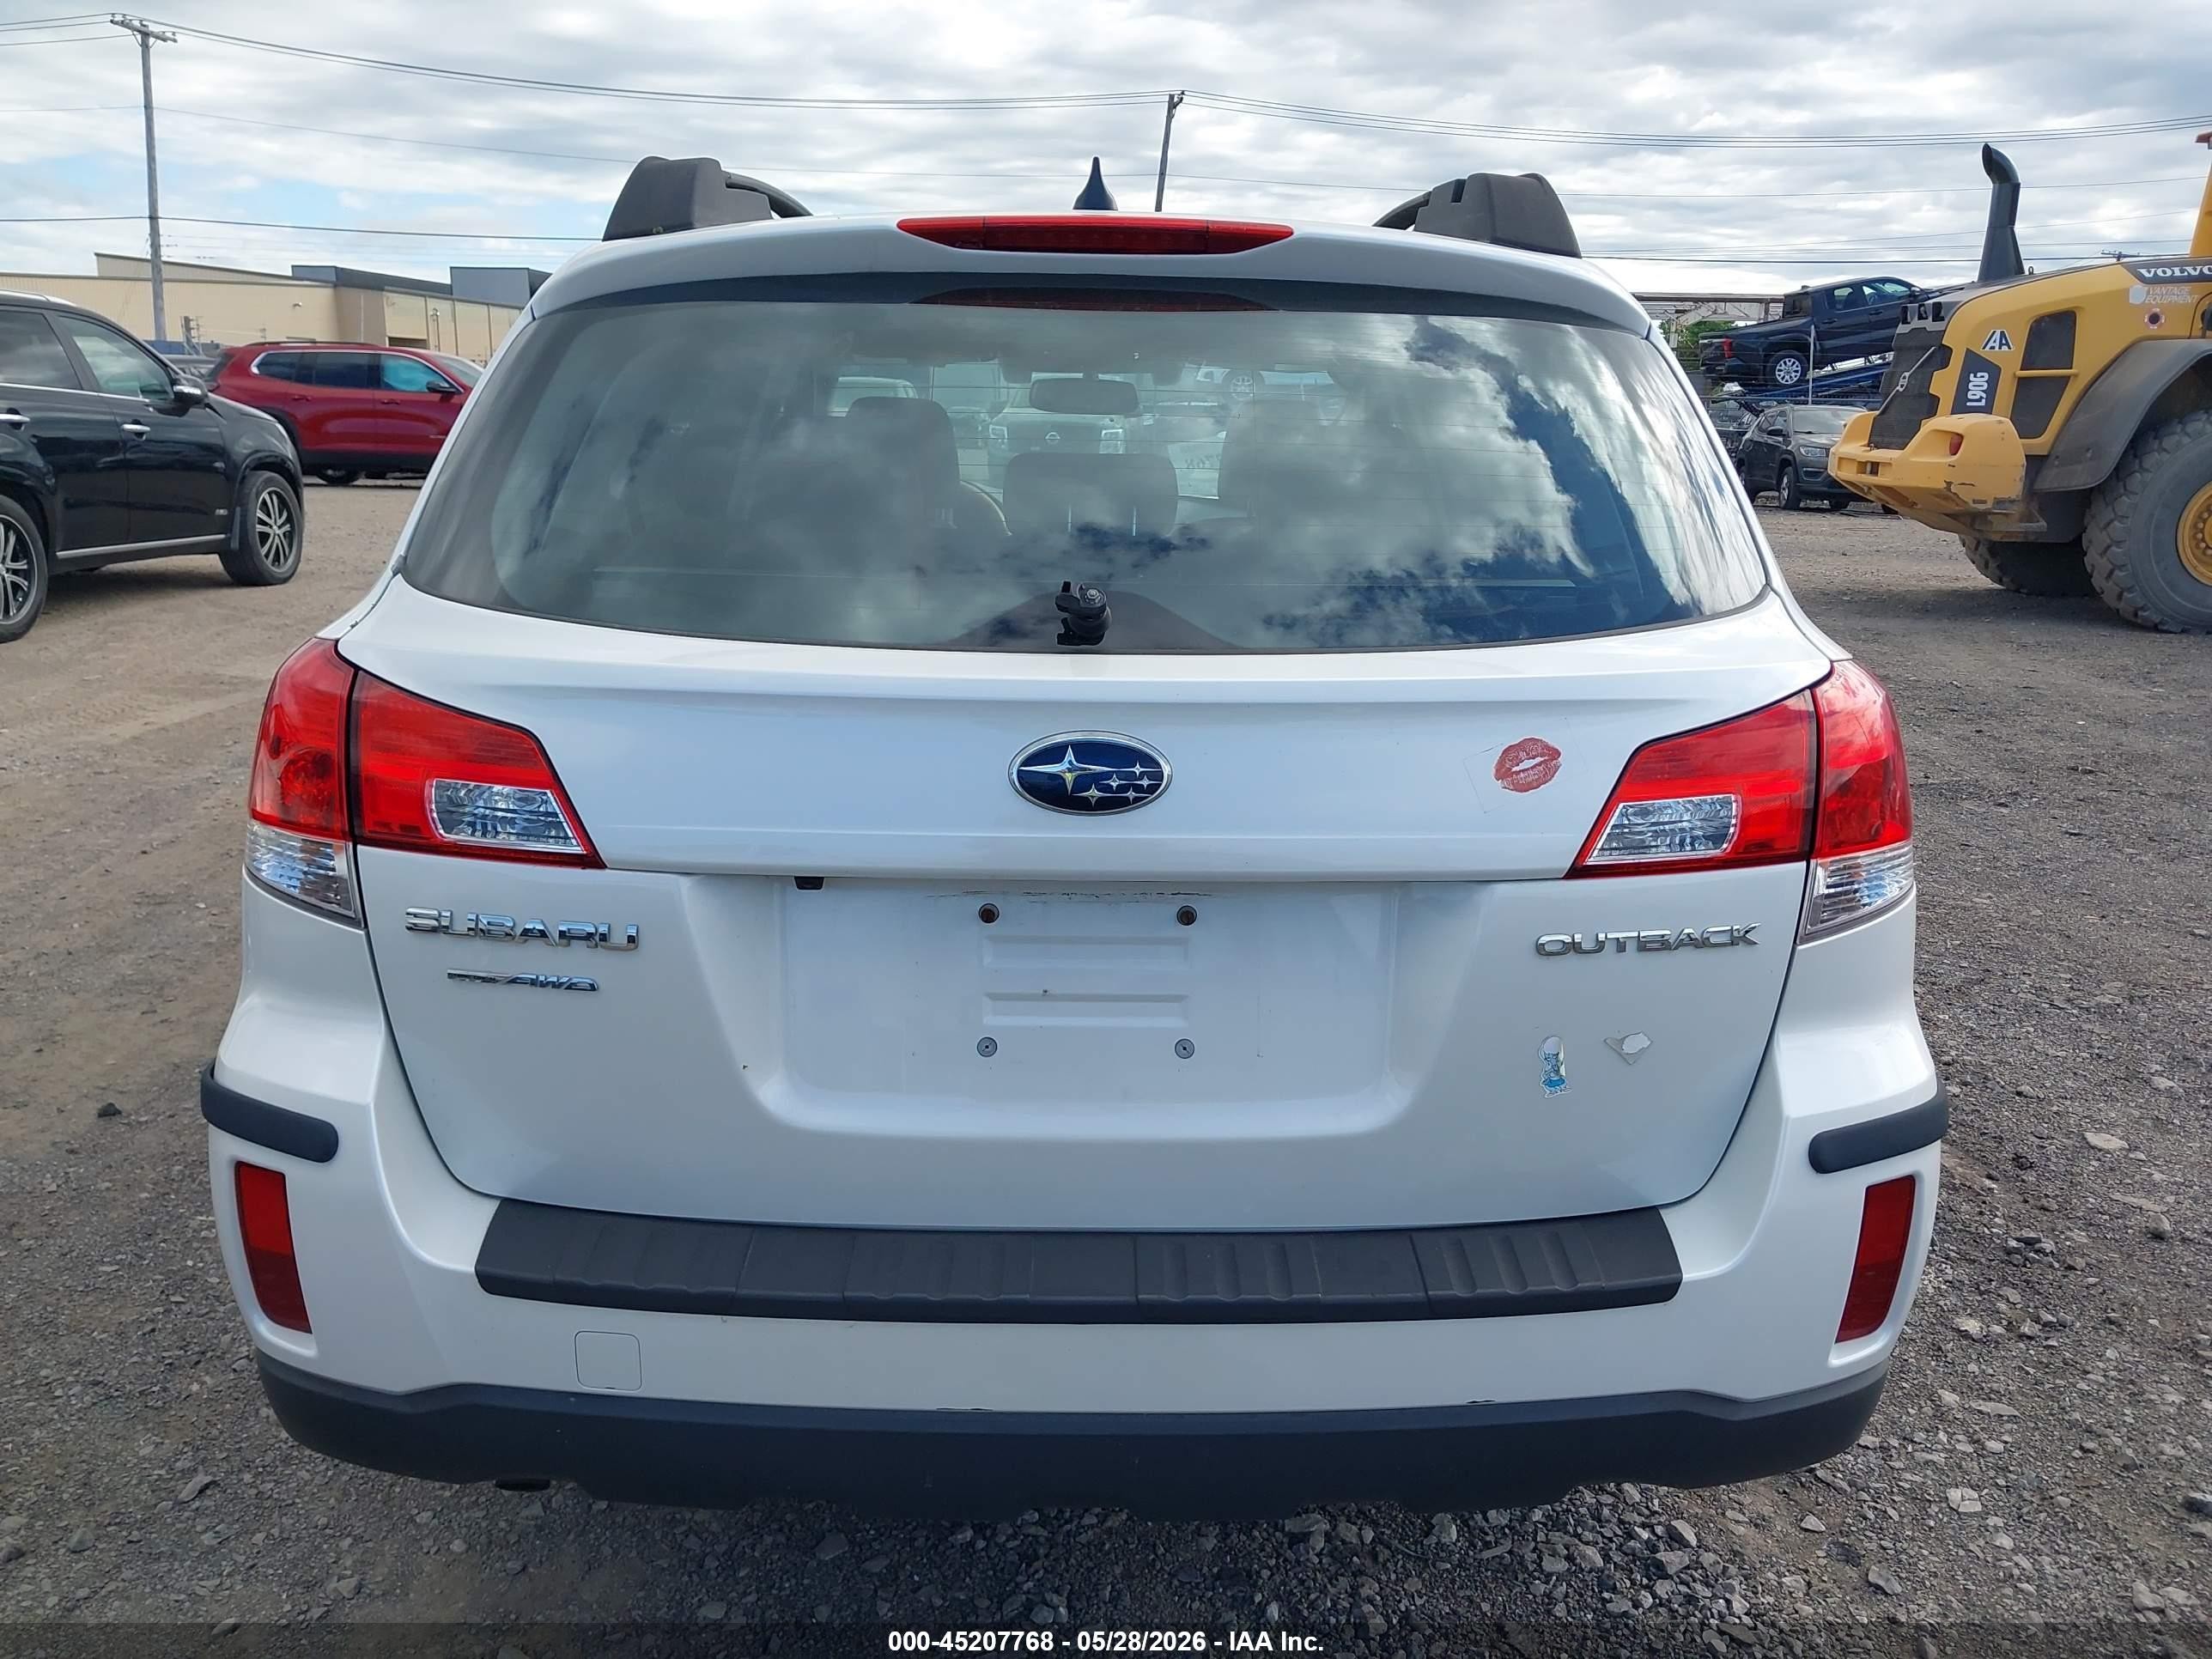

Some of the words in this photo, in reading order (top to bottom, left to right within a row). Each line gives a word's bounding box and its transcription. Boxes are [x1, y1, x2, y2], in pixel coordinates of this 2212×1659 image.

[2136, 264, 2212, 277] VOLVO
[2145, 295, 2198, 304] EQUIPMENT
[2148, 286, 2191, 295] VANTAGE
[1966, 372, 1989, 406] L90G
[404, 906, 640, 951] SUBARU
[1535, 923, 1761, 957] OUTBACK
[503, 972, 599, 992] AWD
